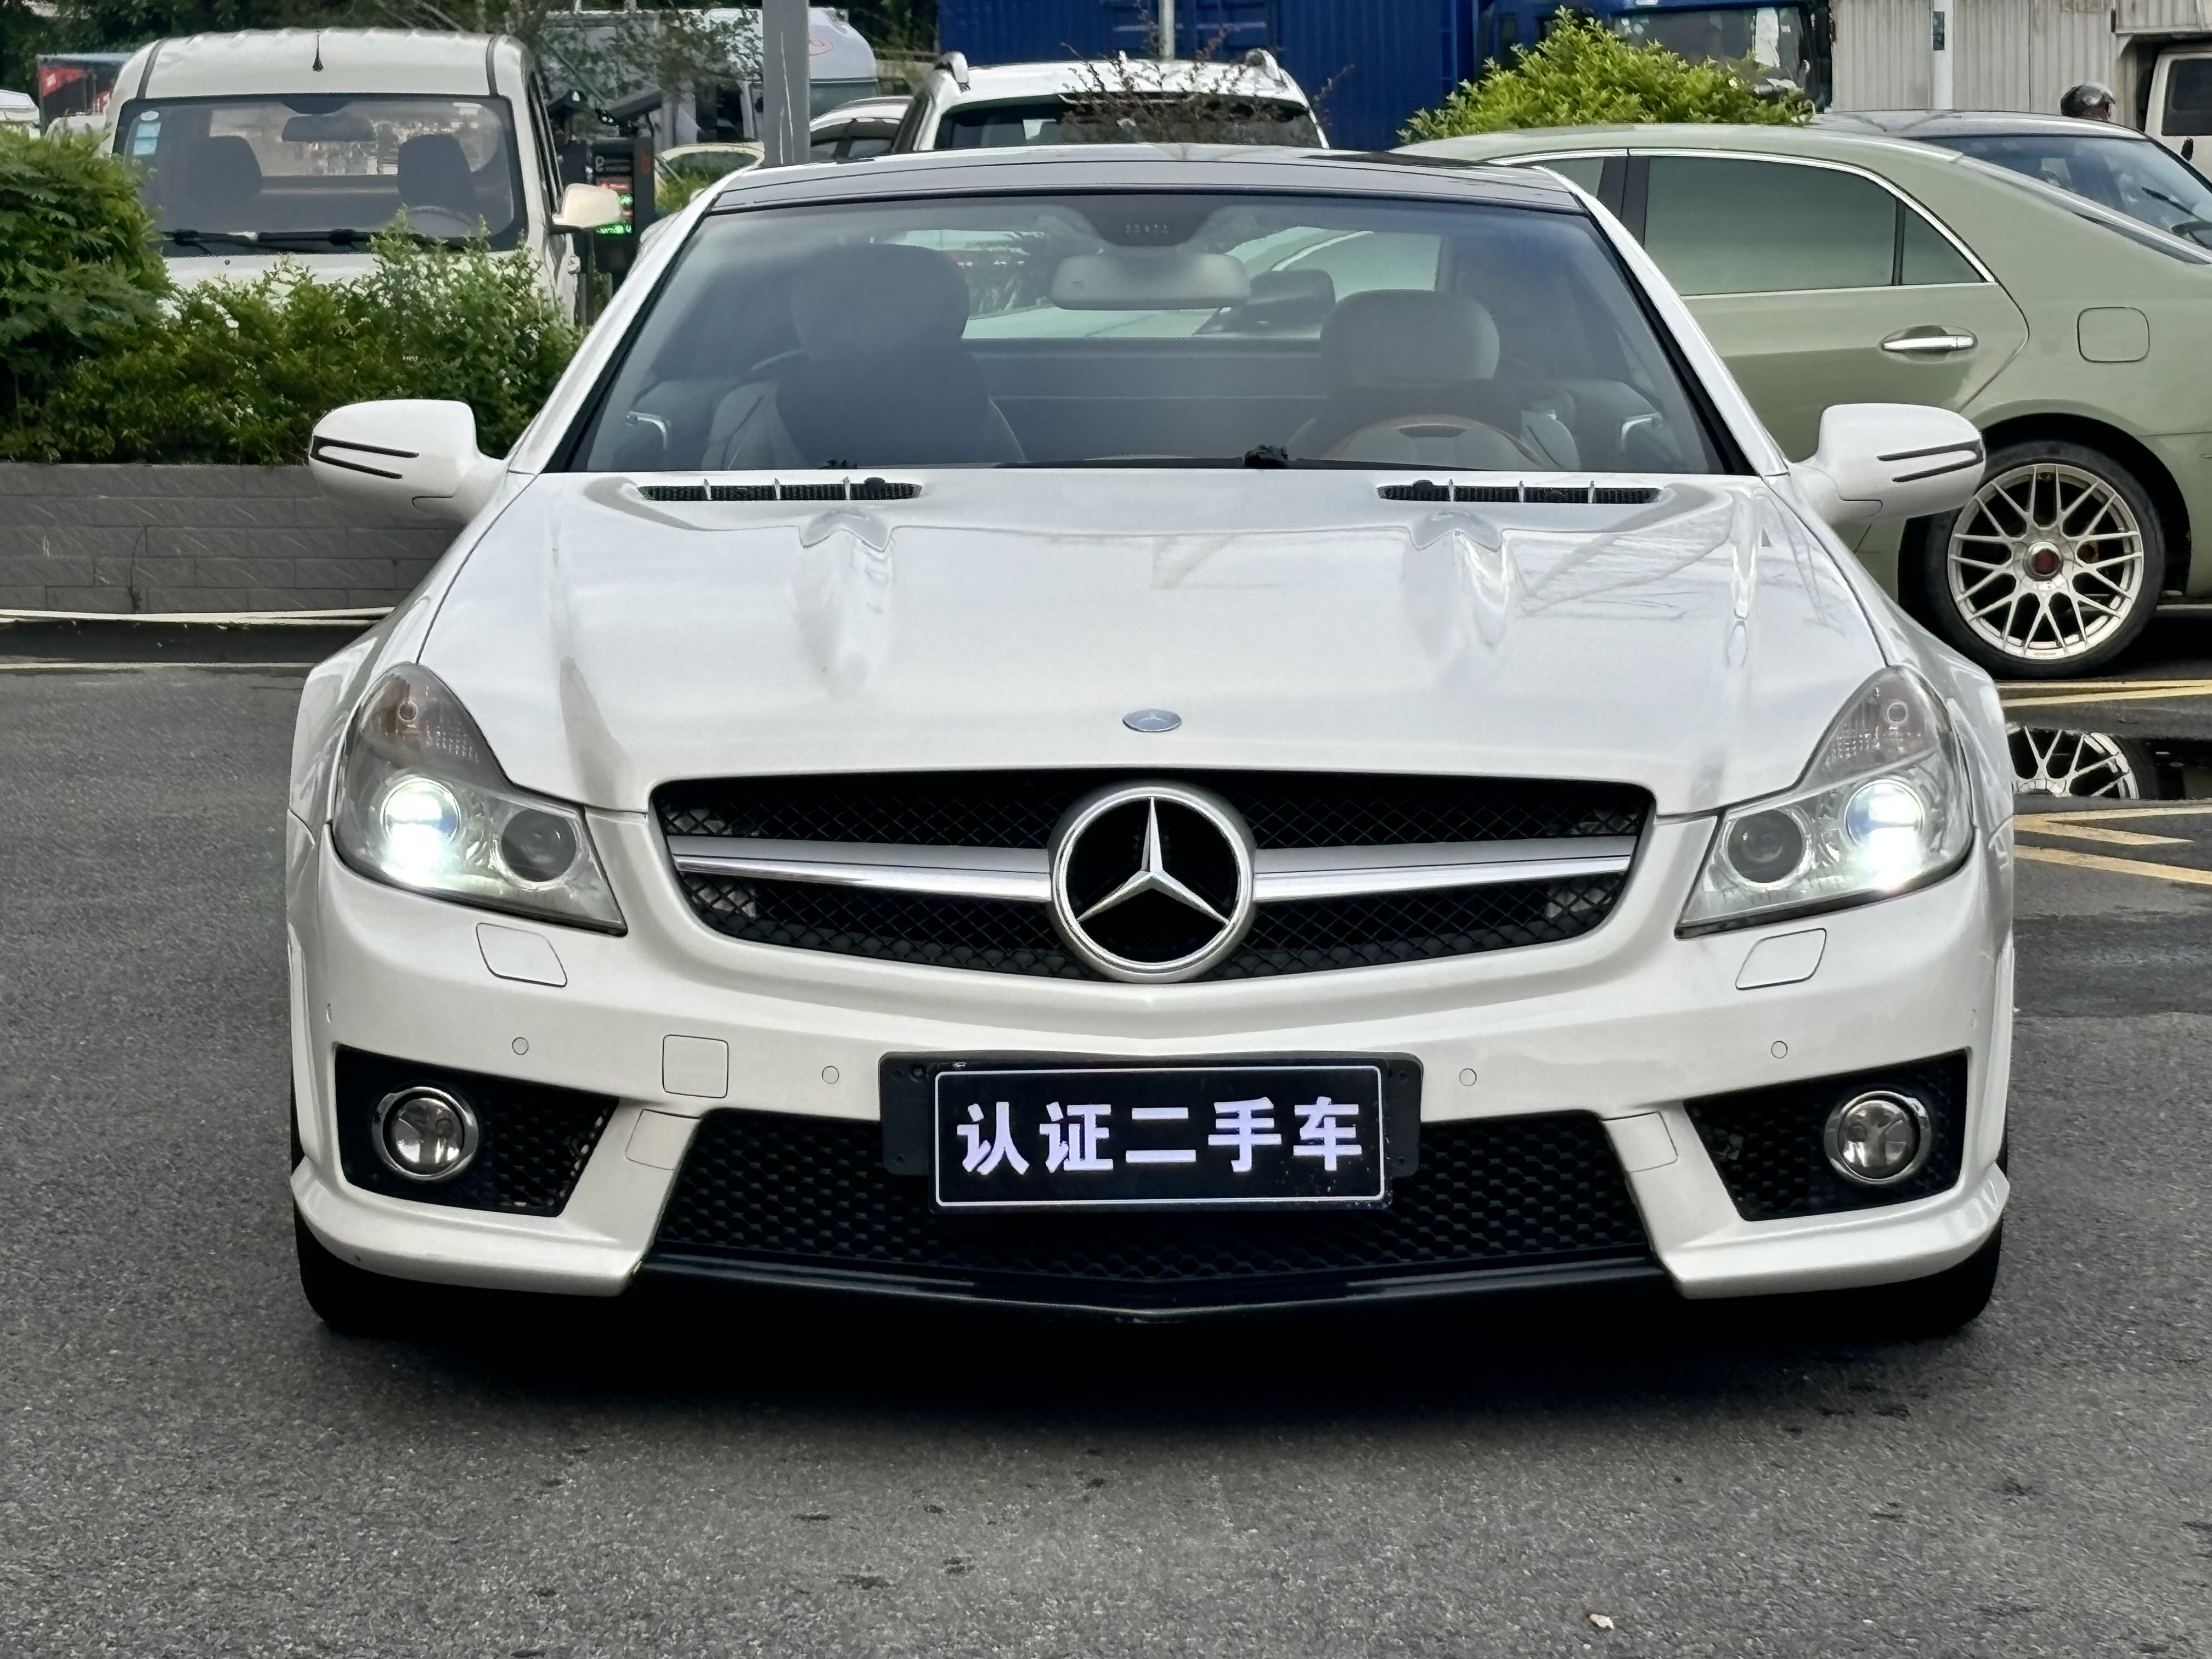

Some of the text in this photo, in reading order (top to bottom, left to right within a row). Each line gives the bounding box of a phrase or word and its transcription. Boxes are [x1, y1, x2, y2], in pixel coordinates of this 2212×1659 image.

[956, 1096, 1363, 1176] 认证二手车
